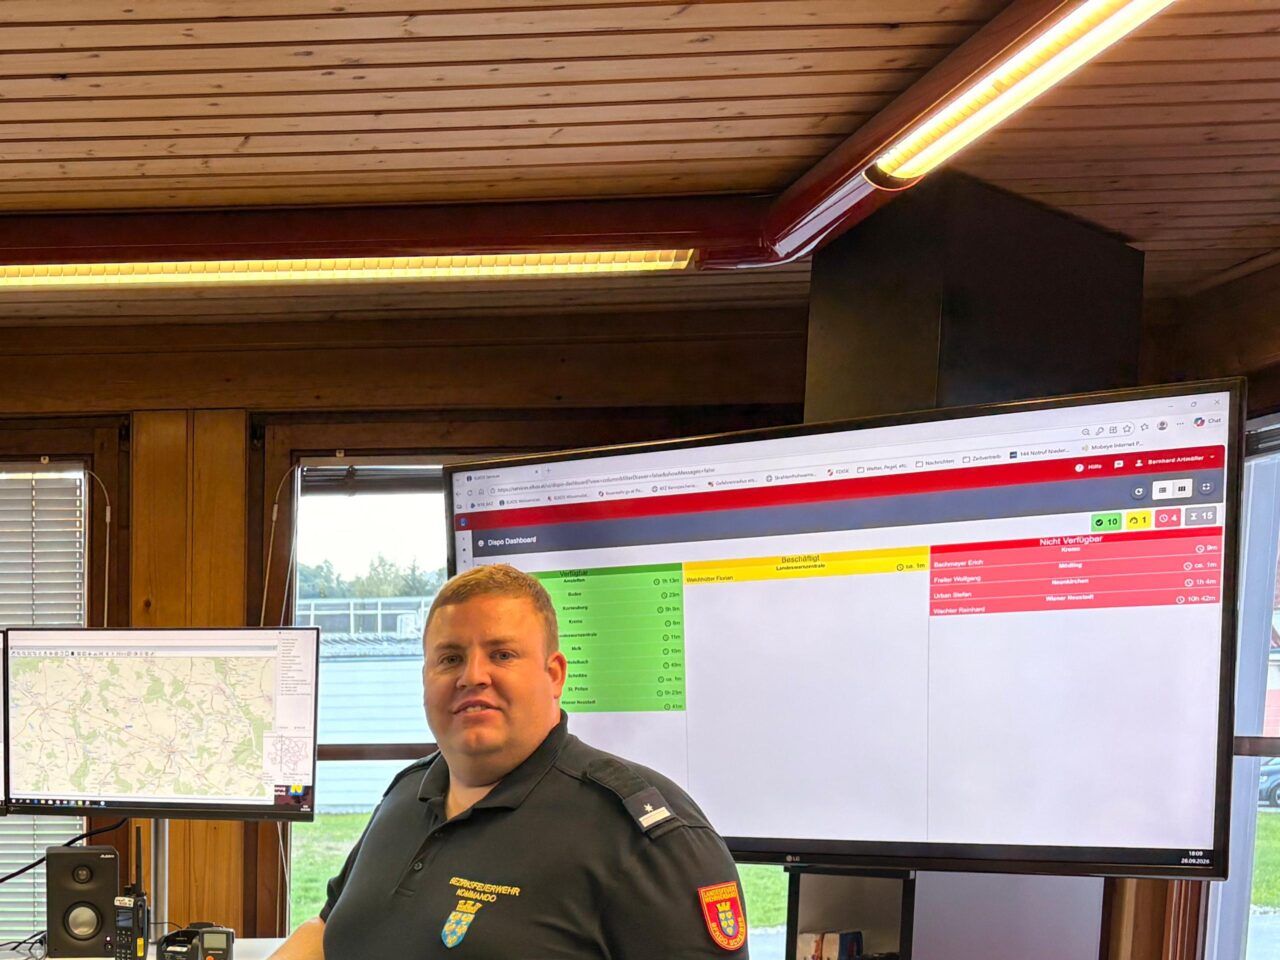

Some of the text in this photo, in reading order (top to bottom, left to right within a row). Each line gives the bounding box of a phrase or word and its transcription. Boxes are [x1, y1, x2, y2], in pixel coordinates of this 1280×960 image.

[1147, 458, 1173, 466] Bernhard
[1171, 514, 1177, 522] 4
[1202, 511, 1213, 520] 15
[1107, 518, 1118, 526] 10
[505, 536, 537, 545] Dashboard
[1040, 535, 1103, 546] Nicht Verfügbar
[781, 554, 820, 564] Beschäftigt
[560, 569, 588, 577] Verfügbar
[954, 574, 982, 583] Wolfgang
[953, 591, 972, 599] Stefan
[456, 889, 496, 902] KOMMANDO
